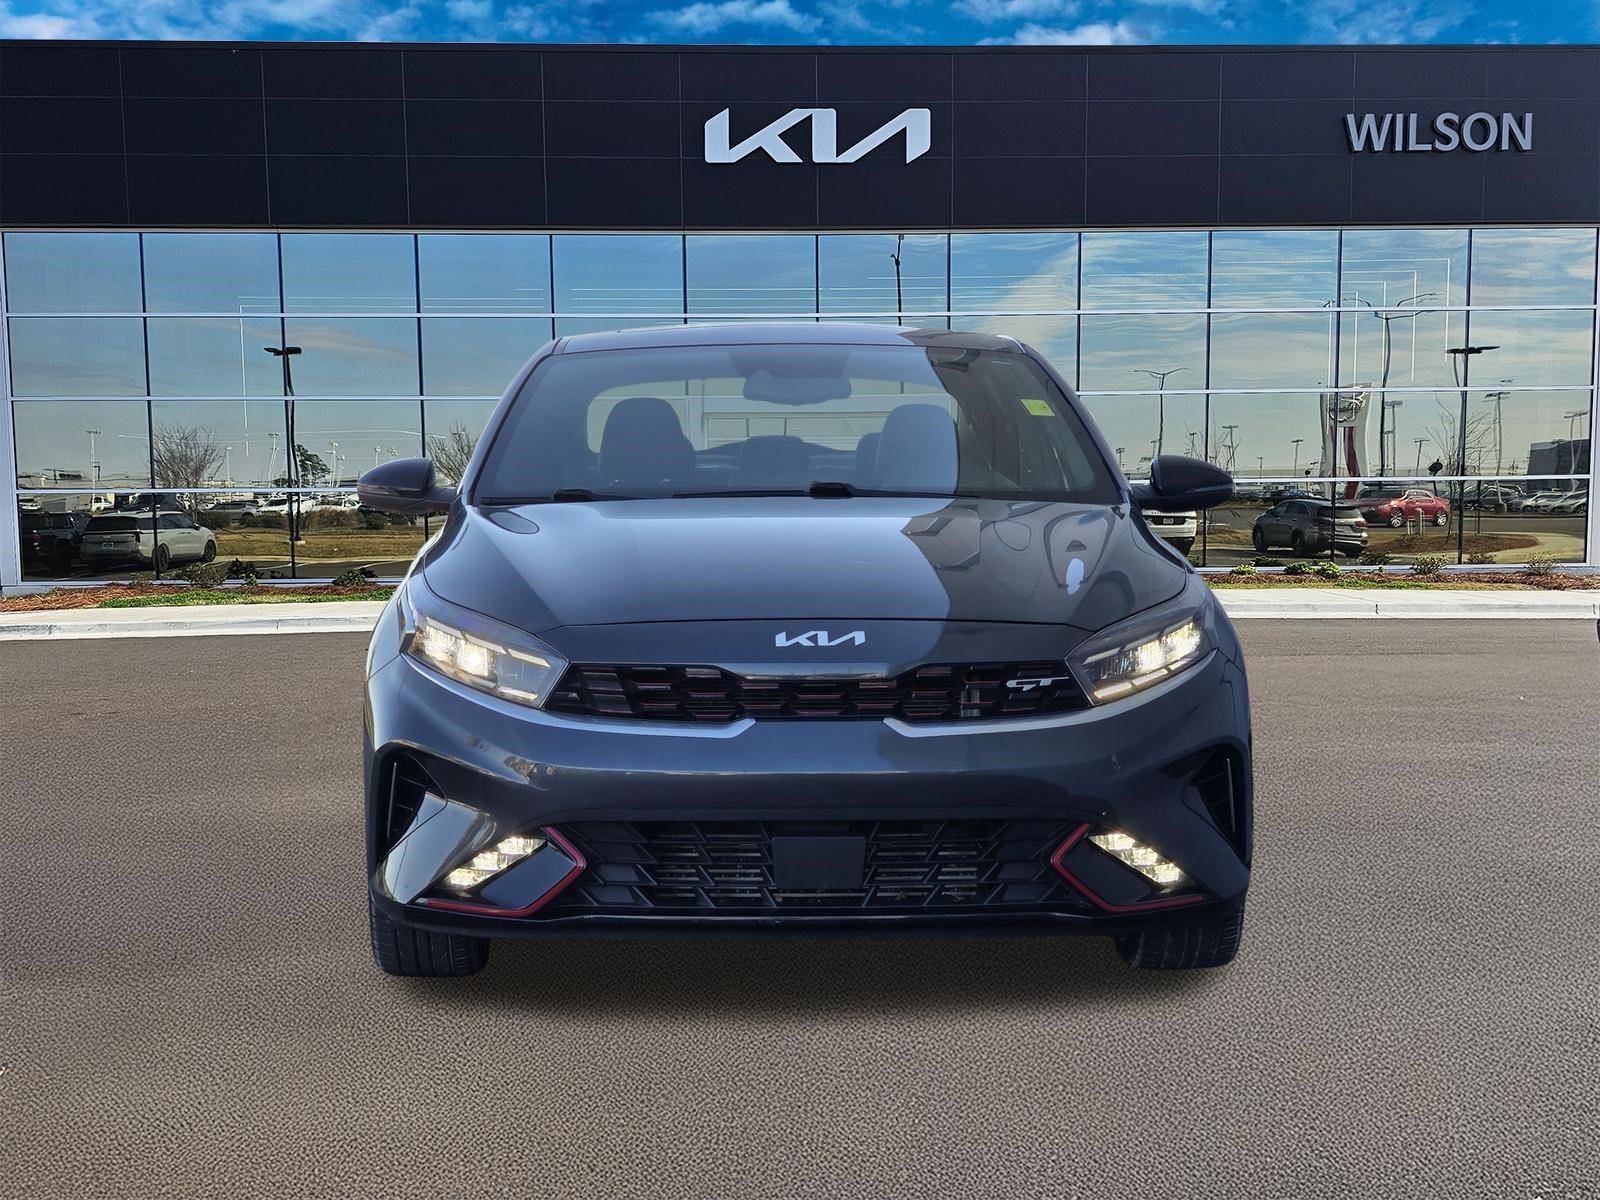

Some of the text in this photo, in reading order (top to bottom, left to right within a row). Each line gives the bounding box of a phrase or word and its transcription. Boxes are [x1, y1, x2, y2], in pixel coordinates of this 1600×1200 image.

[704, 107, 931, 164] KIA
[1345, 112, 1534, 152] WILSON
[775, 630, 866, 647] KIA
[1006, 676, 1070, 692] GT
